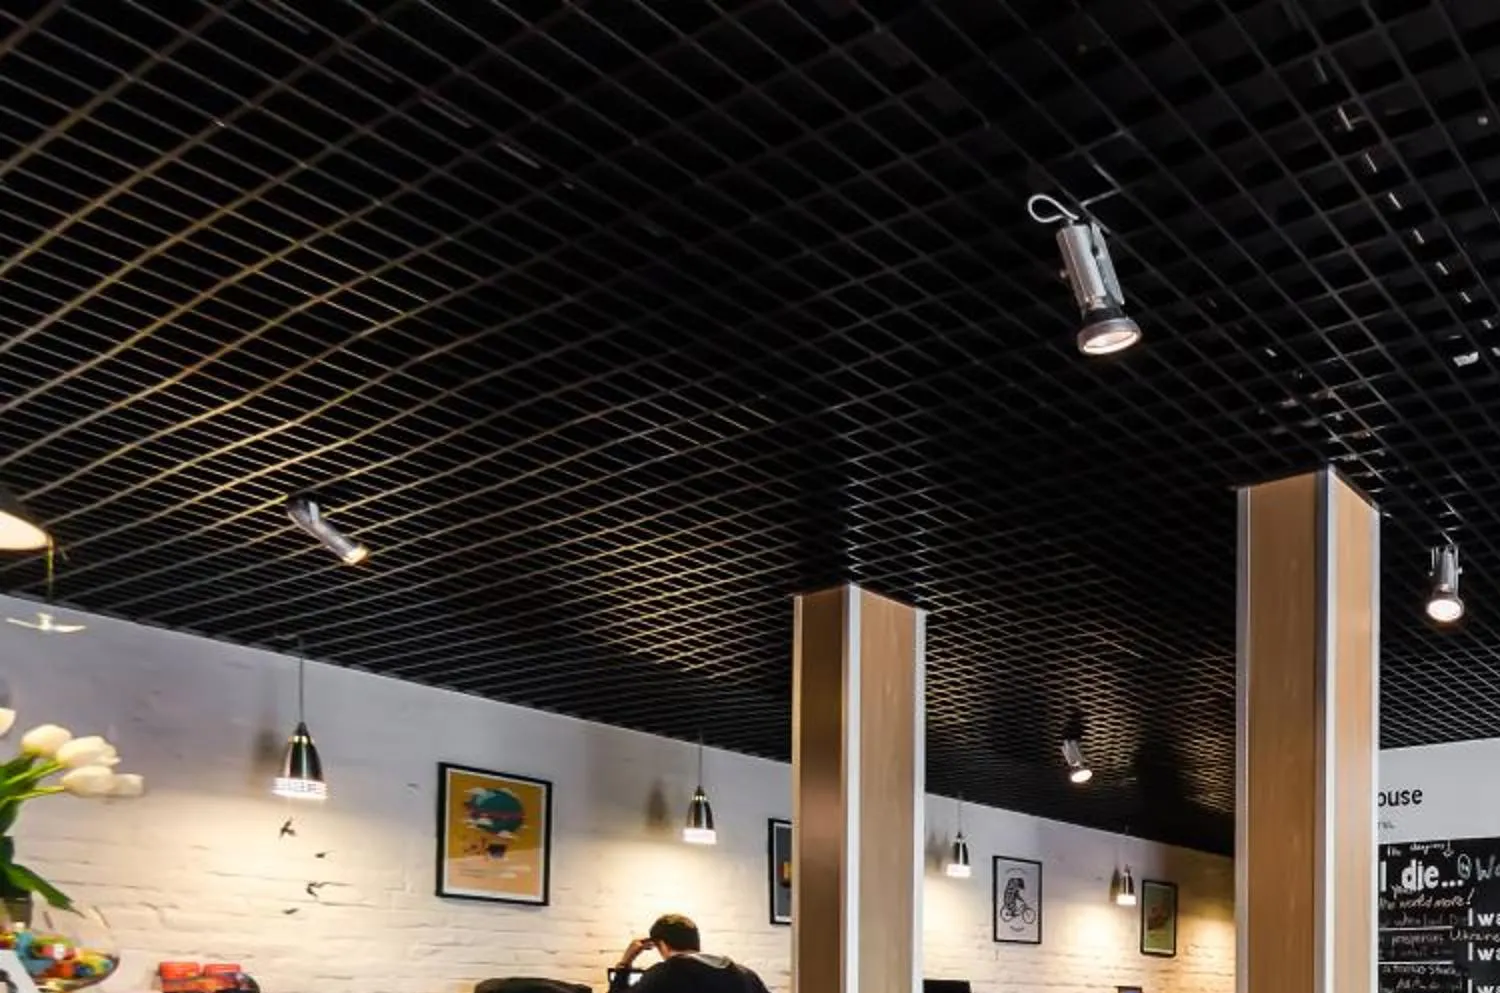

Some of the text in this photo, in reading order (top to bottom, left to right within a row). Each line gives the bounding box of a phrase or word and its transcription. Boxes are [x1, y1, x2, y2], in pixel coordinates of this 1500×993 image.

[1401, 859, 1464, 890] die...
[1468, 908, 1474, 927] I
[1468, 942, 1474, 961] I
